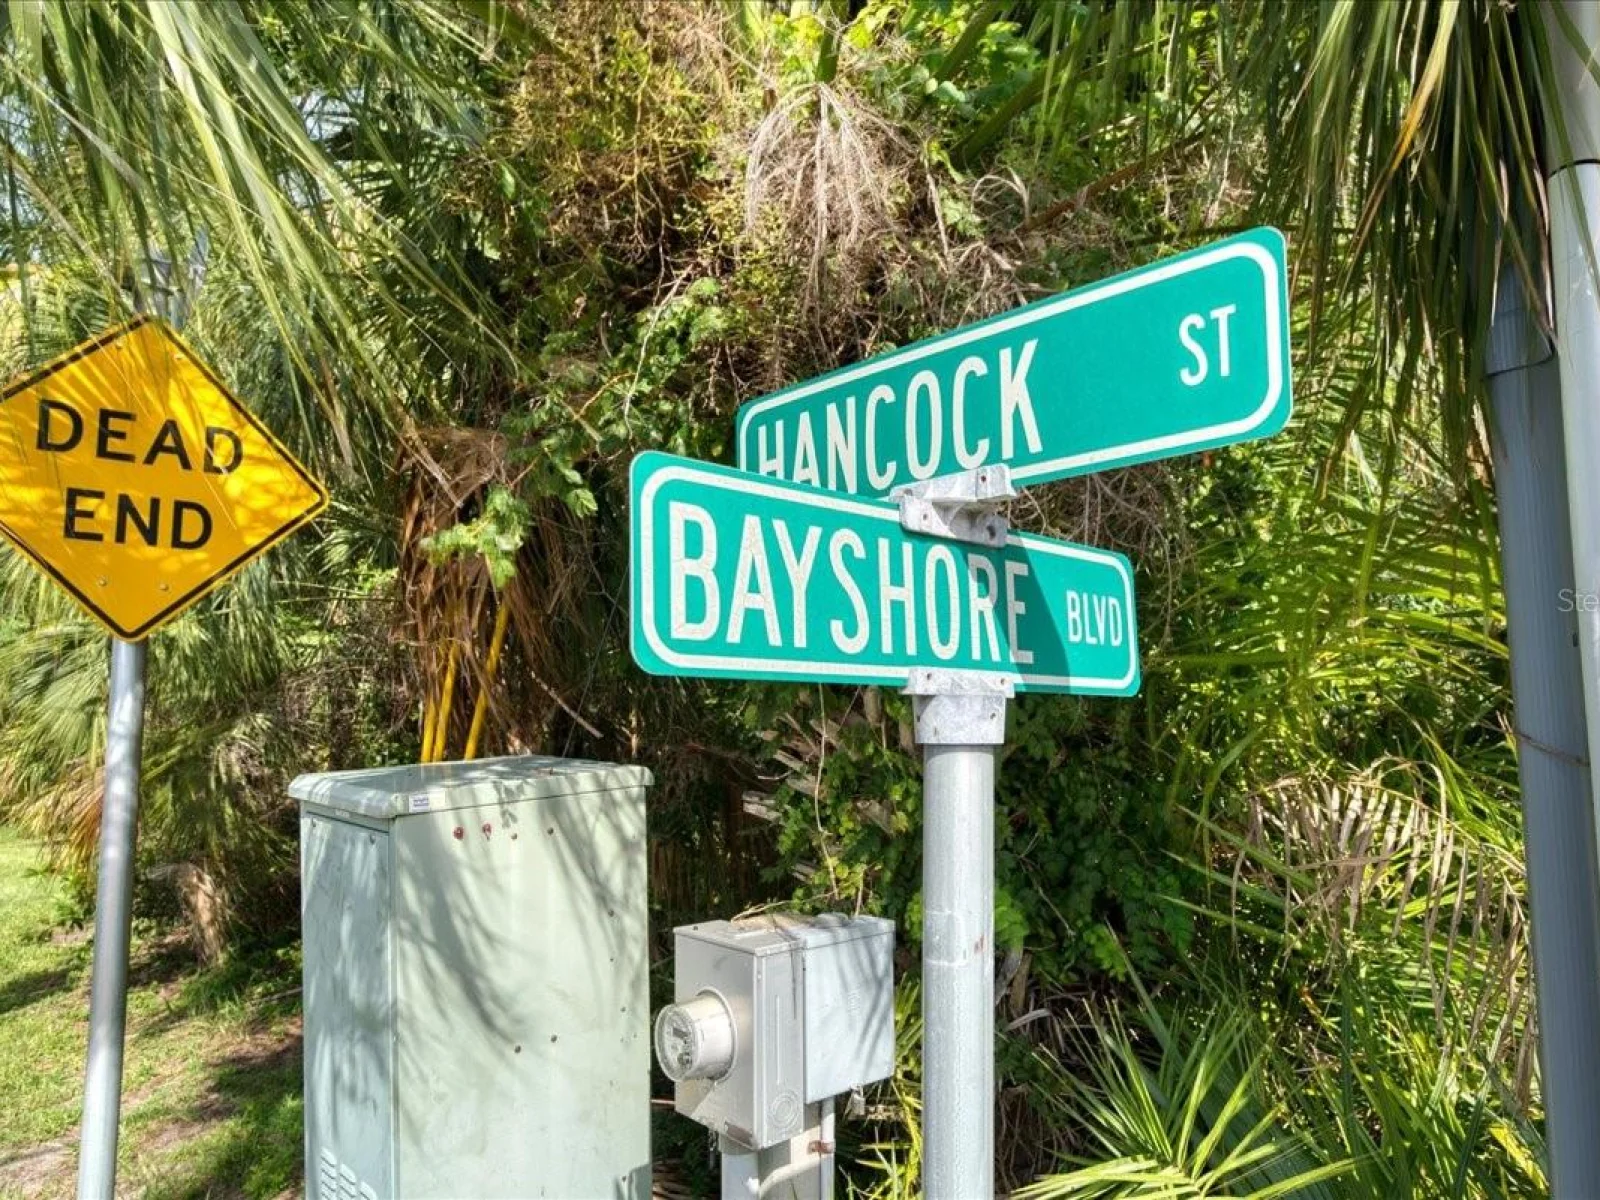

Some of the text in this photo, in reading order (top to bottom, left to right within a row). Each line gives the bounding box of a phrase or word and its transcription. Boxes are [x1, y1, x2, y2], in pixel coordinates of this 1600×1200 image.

[36, 399, 244, 476] DEAD
[757, 303, 1237, 495] HANCOCK ST
[63, 487, 214, 550] END
[668, 500, 1124, 665] BAYSHORE BLVD
